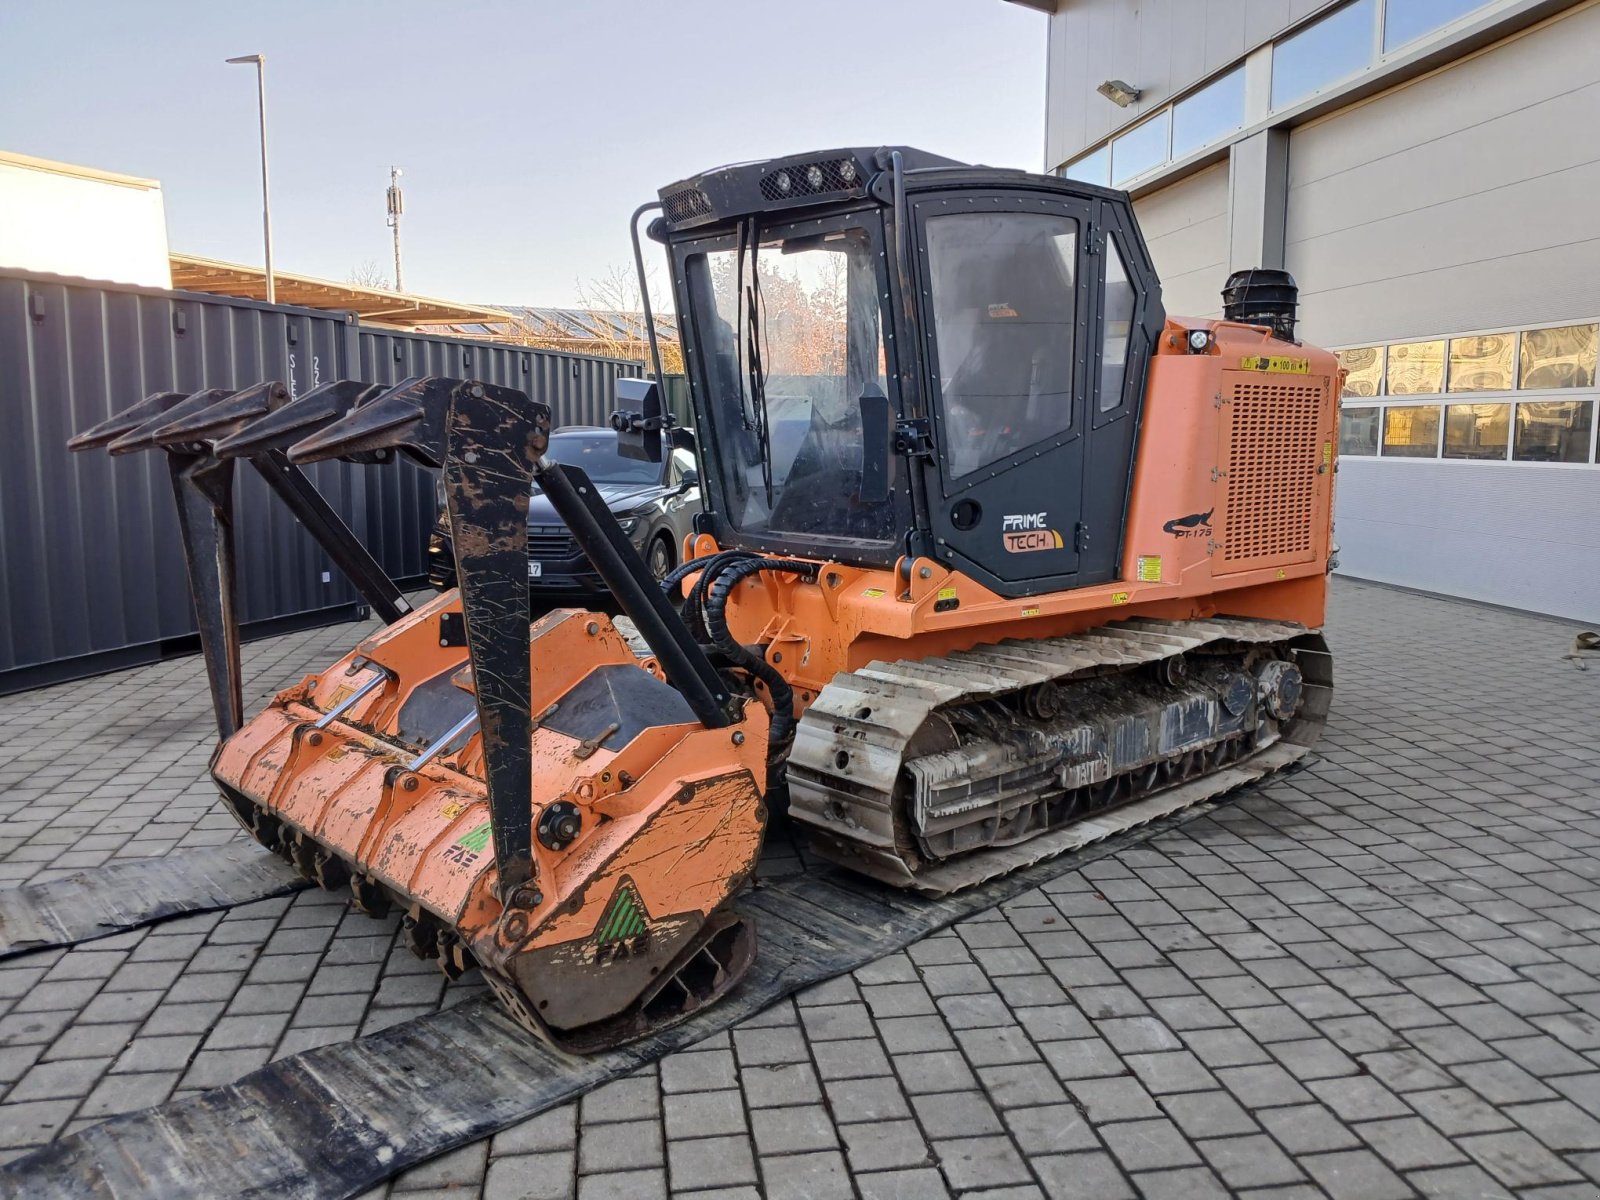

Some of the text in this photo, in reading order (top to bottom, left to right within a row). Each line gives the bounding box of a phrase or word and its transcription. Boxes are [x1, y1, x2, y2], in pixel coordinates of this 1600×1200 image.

[1280, 360, 1290, 370] 100
[1003, 512, 1047, 531] PRIME
[1008, 533, 1047, 550] TECH
[1175, 529, 1213, 539] PT-175
[442, 845, 479, 868] FAE
